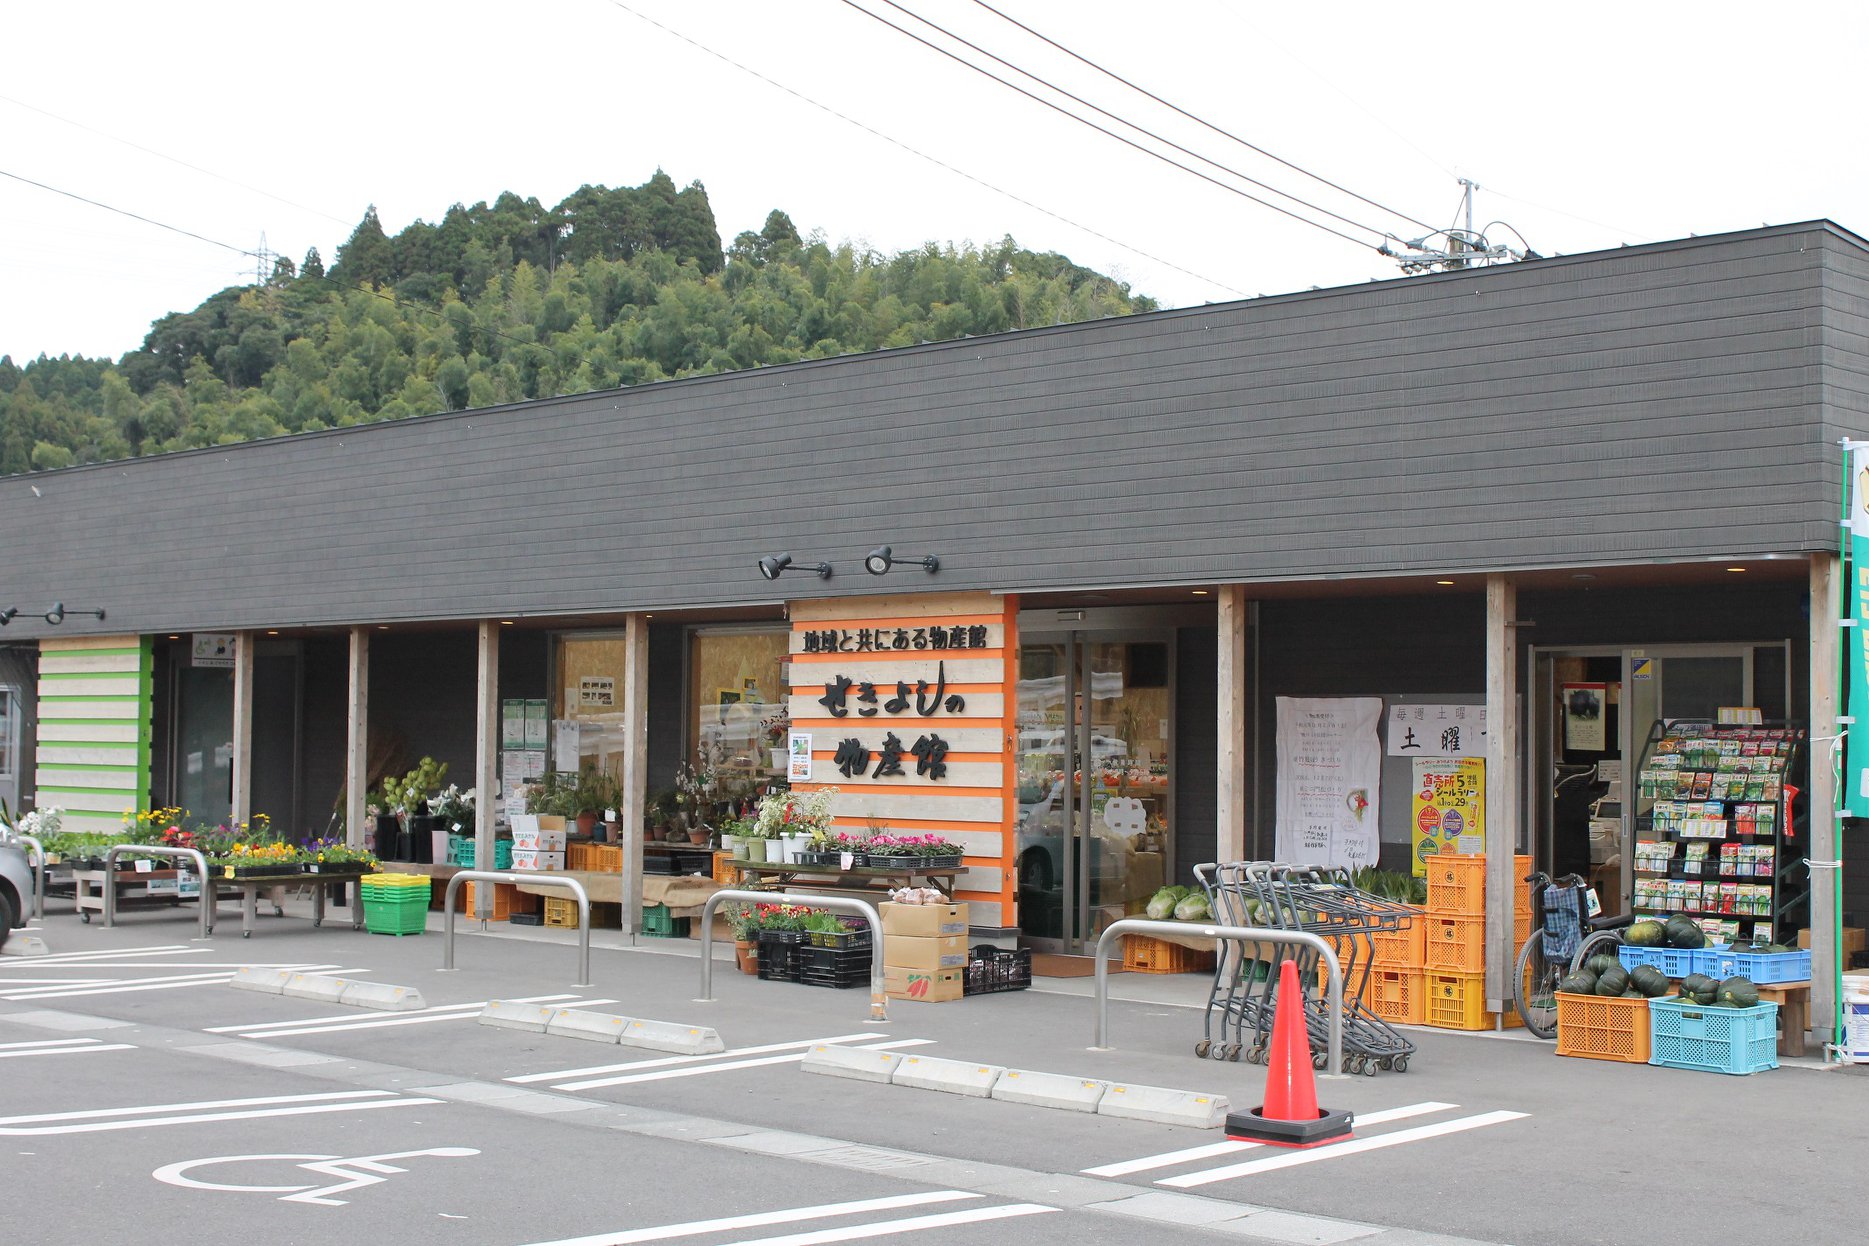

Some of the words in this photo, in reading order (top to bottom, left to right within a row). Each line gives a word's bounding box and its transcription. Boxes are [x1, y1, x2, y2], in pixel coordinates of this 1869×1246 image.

[802, 625, 988, 653] 地域と共にある物産館
[818, 660, 966, 718] せきよしの
[833, 731, 949, 781] 物産館
[1423, 773, 1455, 788] 直売所
[1456, 774, 1466, 788] 5
[1436, 787, 1475, 797] シールラリー
